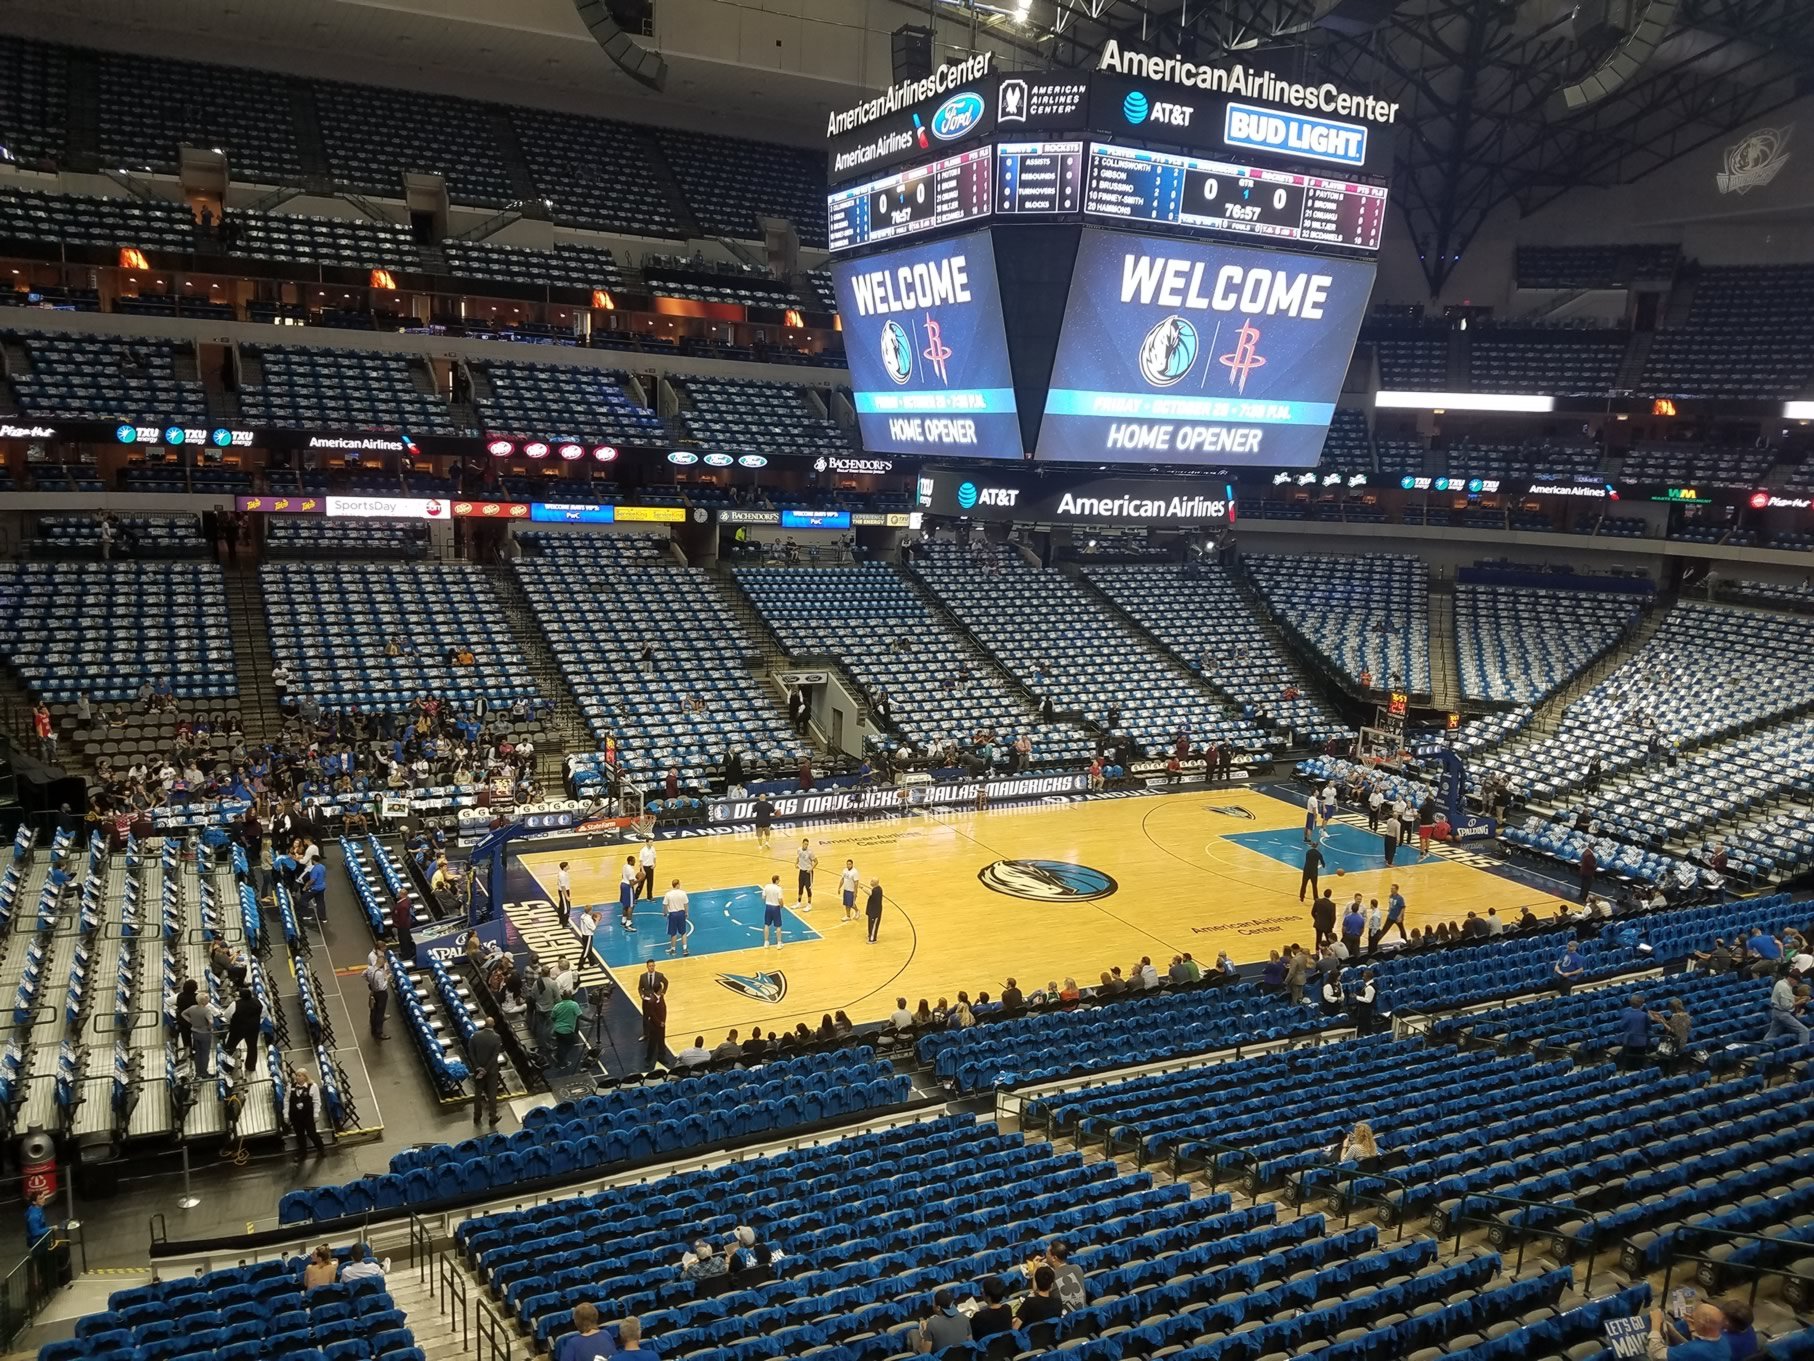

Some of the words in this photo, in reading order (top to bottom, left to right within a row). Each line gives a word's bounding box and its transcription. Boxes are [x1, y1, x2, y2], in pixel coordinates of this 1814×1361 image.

[1032, 85, 1086, 94] AMERICAN
[1031, 95, 1080, 104] AIRLINES
[1151, 101, 1194, 127] AT&T
[1231, 111, 1286, 145] BUD
[1006, 158, 1012, 166] 0
[1067, 157, 1073, 165] 0
[1066, 171, 1072, 179] 0
[1101, 169, 1127, 180] GIBSON
[917, 183, 925, 203] 0
[1004, 187, 1010, 195] 0
[1019, 187, 1056, 195] TURNOVERS
[1204, 178, 1218, 200] 0
[1273, 188, 1287, 209] 0
[1243, 189, 1249, 199] 1
[879, 194, 887, 214] 0
[1004, 201, 1010, 209] 0
[1065, 200, 1070, 208] 0
[1225, 203, 1262, 220] 76:57
[851, 255, 971, 316] WELCOME
[1121, 254, 1332, 319] WELCOME
[136, 427, 159, 437] TXU
[184, 429, 207, 438] TXU
[232, 430, 254, 440] TXU
[889, 418, 924, 442] HOME
[924, 418, 977, 444] OPENER
[309, 437, 361, 448] American
[362, 438, 403, 450] Airlines
[1106, 423, 1173, 450] HOME
[1176, 426, 1263, 453] OPENER
[1529, 484, 1572, 495] American
[1571, 487, 1605, 497] Airlines
[979, 488, 1019, 507] AT&T
[335, 500, 397, 513] SportsDay
[1057, 493, 1165, 517] American
[1166, 496, 1225, 517] Airlines
[925, 783, 981, 802] DALLAS
[985, 776, 1073, 797] MAVERICKS
[1070, 787, 1169, 801] FANDUEL
[1457, 824, 1489, 837] SPALDING
[1238, 925, 1284, 935] Center
[1604, 1318, 1632, 1336] LET'S
[1630, 1316, 1646, 1330] GO
